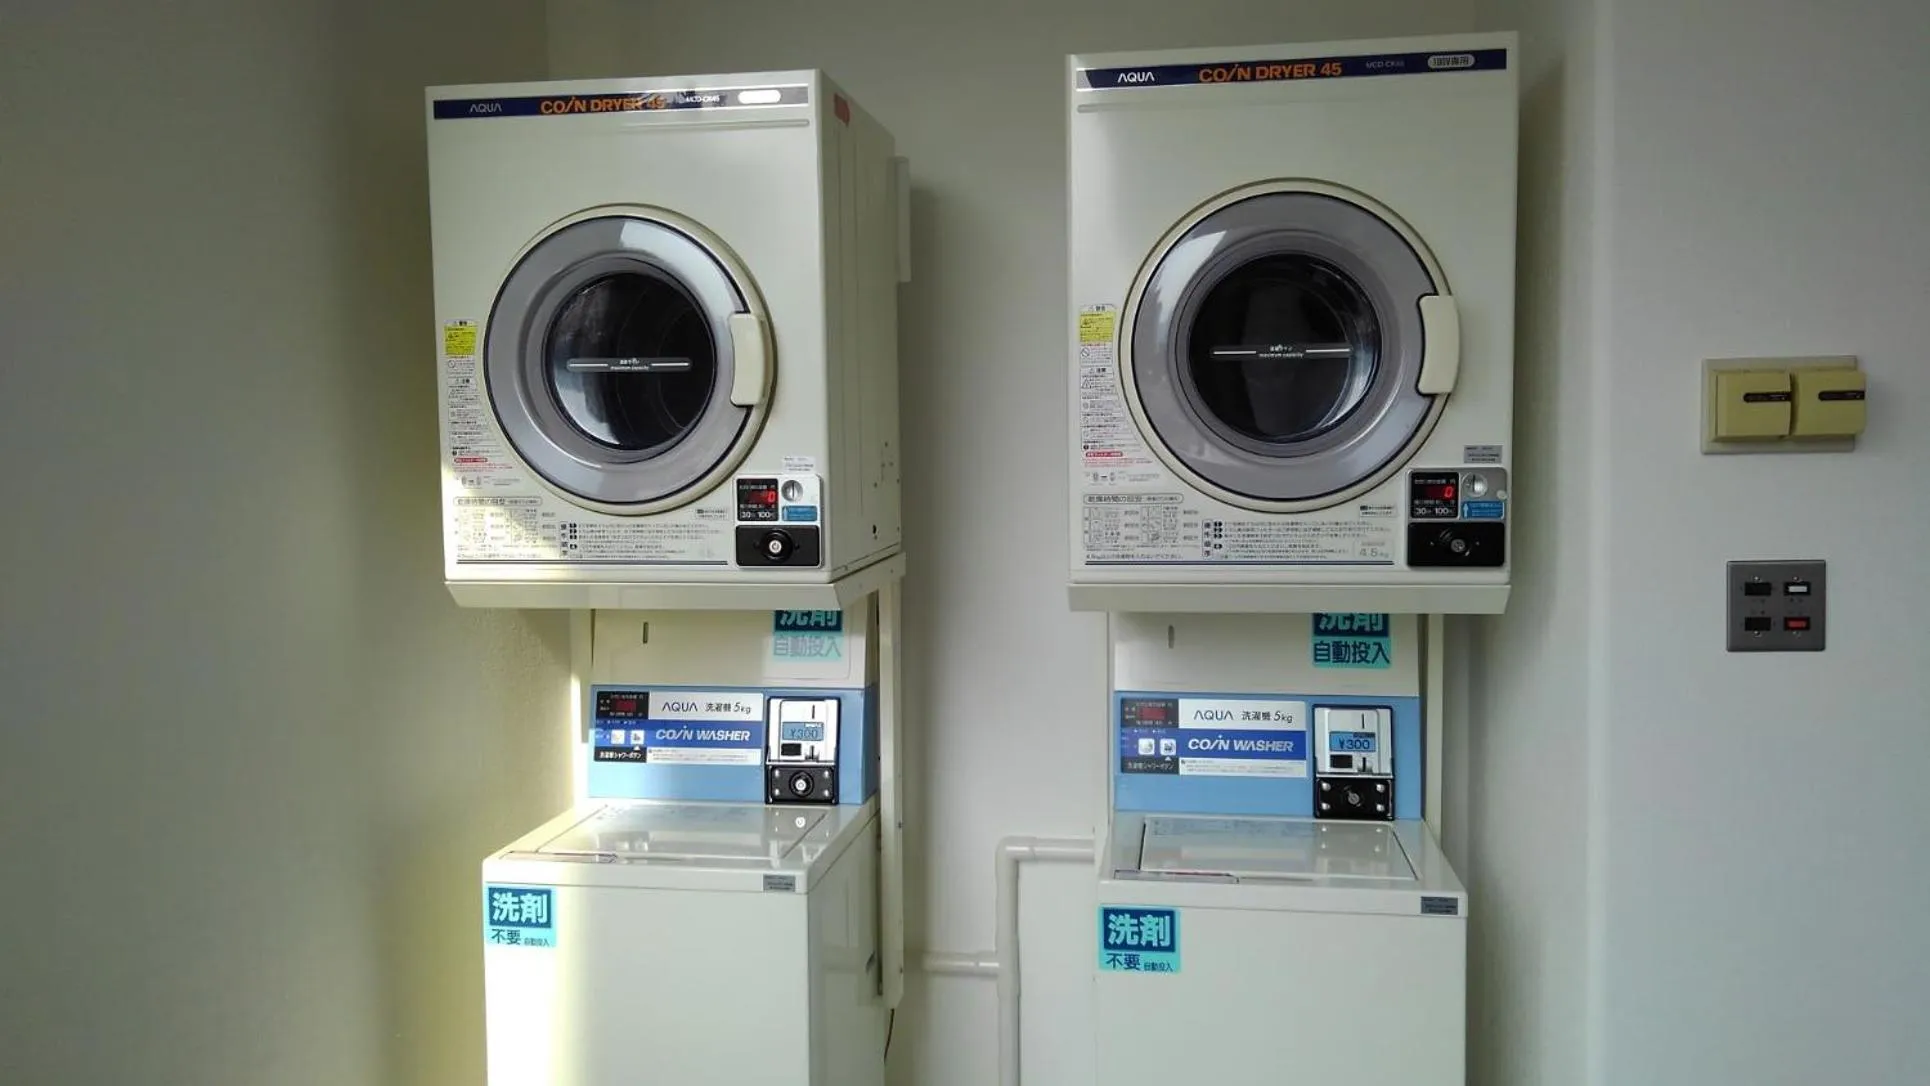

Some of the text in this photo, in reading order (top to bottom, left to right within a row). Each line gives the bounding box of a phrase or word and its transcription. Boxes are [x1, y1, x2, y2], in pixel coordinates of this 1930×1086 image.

[1117, 71, 1156, 83] AQUA
[1255, 63, 1316, 80] DRYER
[1320, 62, 1343, 76] 45
[470, 103, 503, 113] AQUA
[590, 98, 642, 112] DRYER
[767, 491, 776, 503] 0
[1444, 486, 1454, 498] 0
[773, 636, 842, 658] 自動投入
[1313, 641, 1390, 664] 自動投入
[661, 702, 698, 712] AQUA
[1193, 710, 1234, 721] AQUA
[696, 730, 750, 742] WASHER
[1339, 737, 1370, 750] ¥300
[1233, 739, 1294, 752] WASHER
[492, 892, 548, 924] 洗剤
[491, 929, 522, 945] 不要
[1108, 913, 1171, 947] 洗剤
[1106, 953, 1141, 971] 不要
